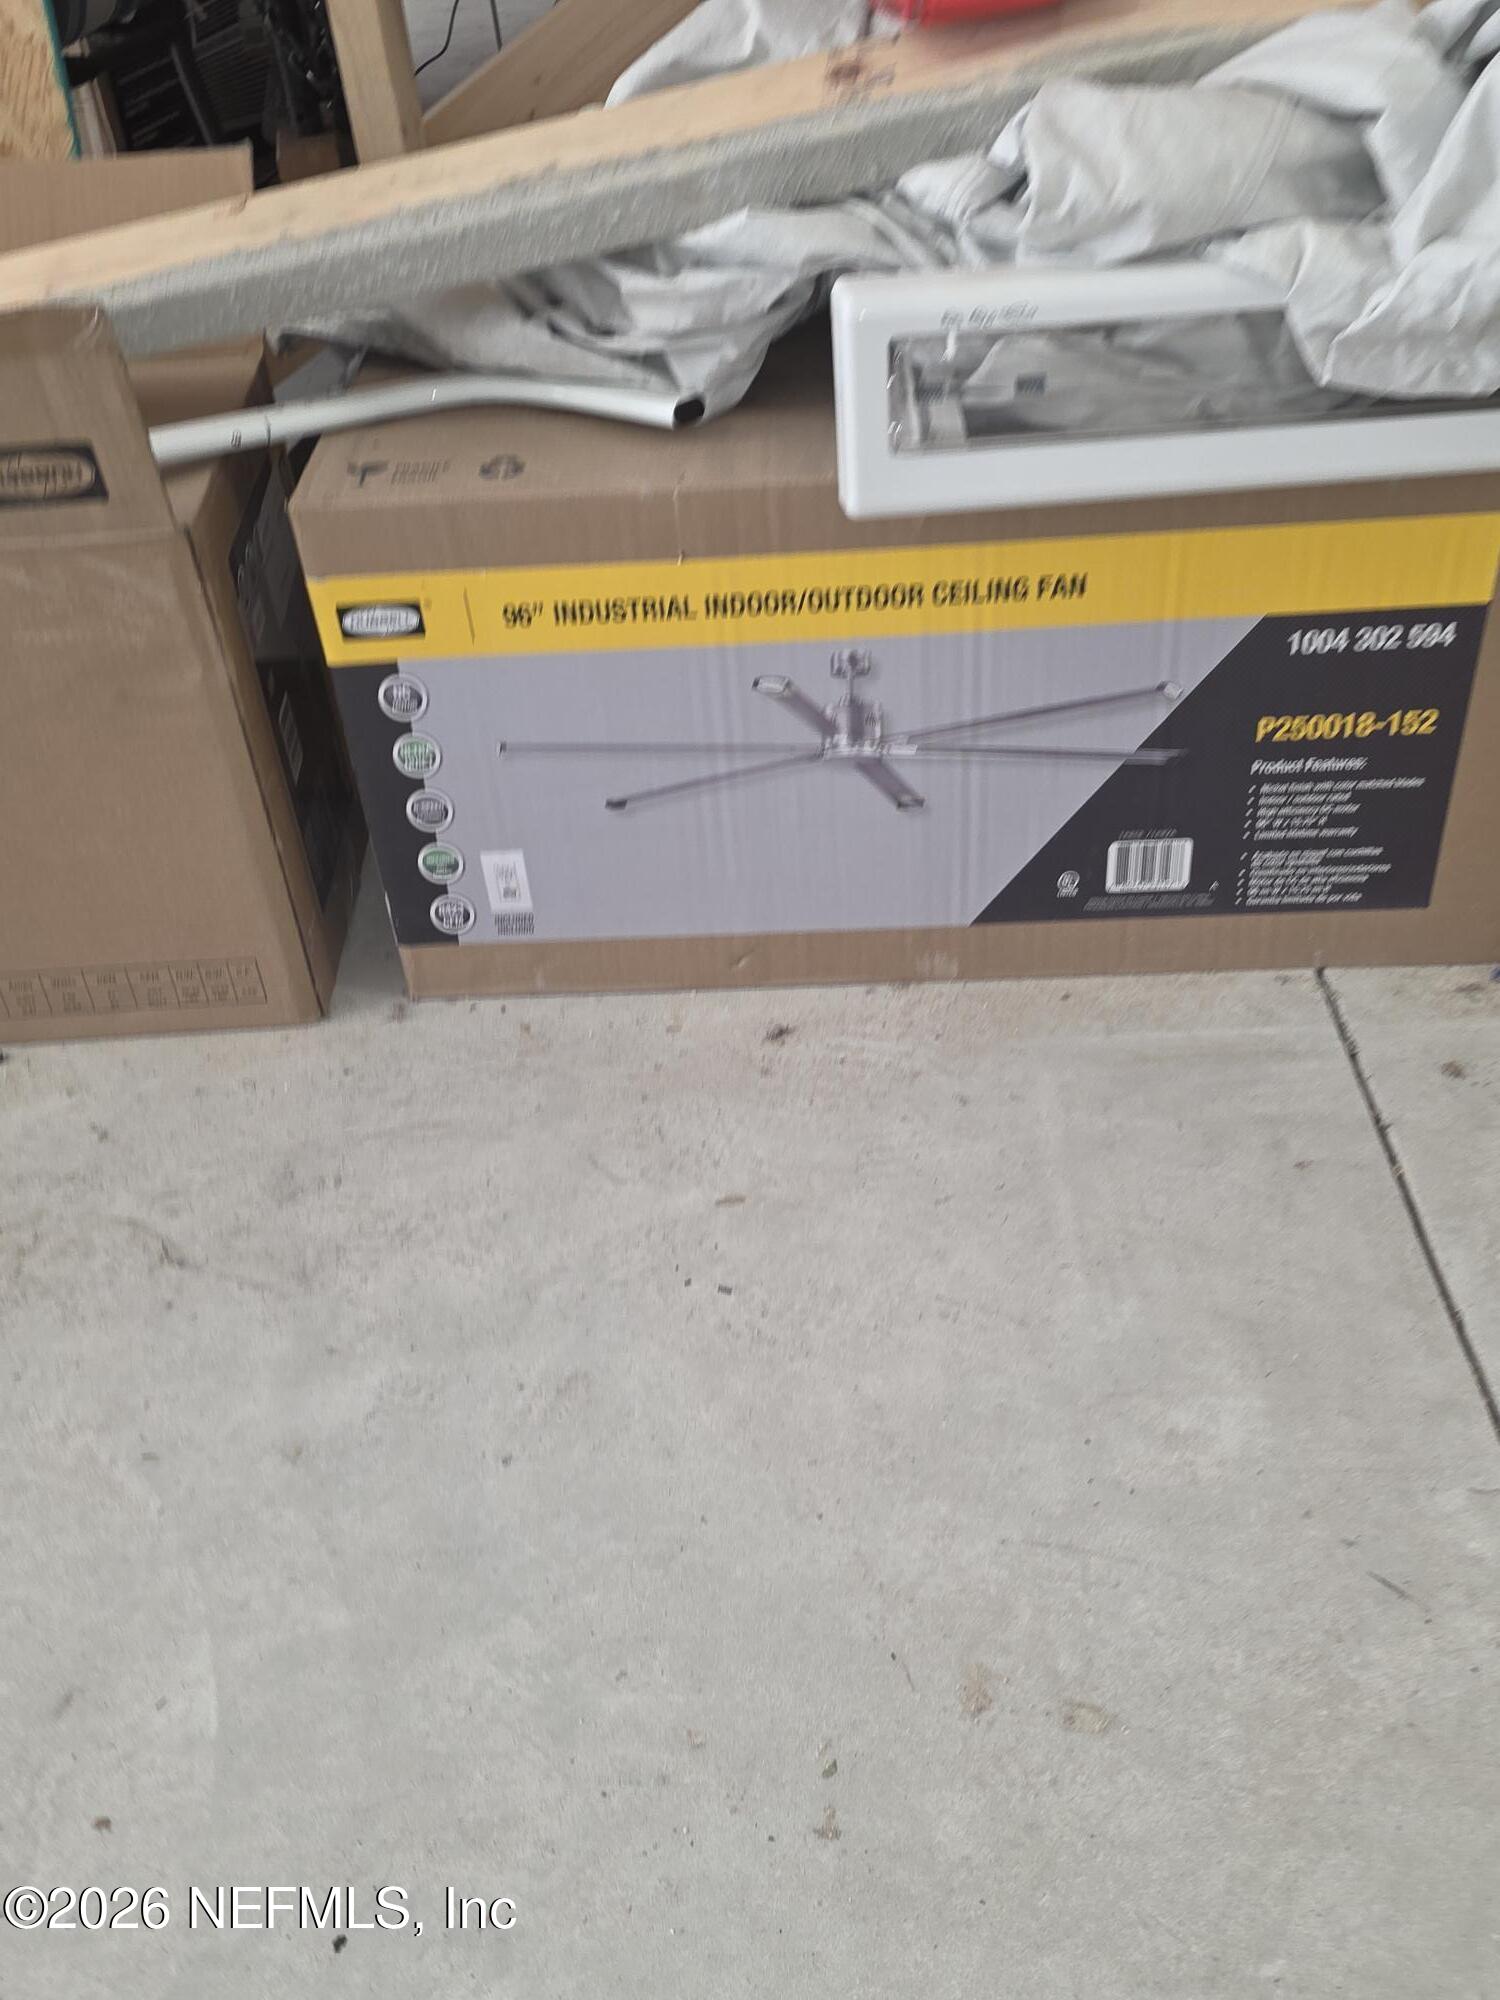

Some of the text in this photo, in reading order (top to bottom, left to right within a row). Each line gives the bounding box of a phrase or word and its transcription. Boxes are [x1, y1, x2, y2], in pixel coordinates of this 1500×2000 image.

[502, 571, 1088, 629] 96" INDUSTRIAL INDOOR/OUTDOOR CEILING FAN
[1287, 626, 1350, 656] 1004
[1250, 758, 1304, 775] Product
